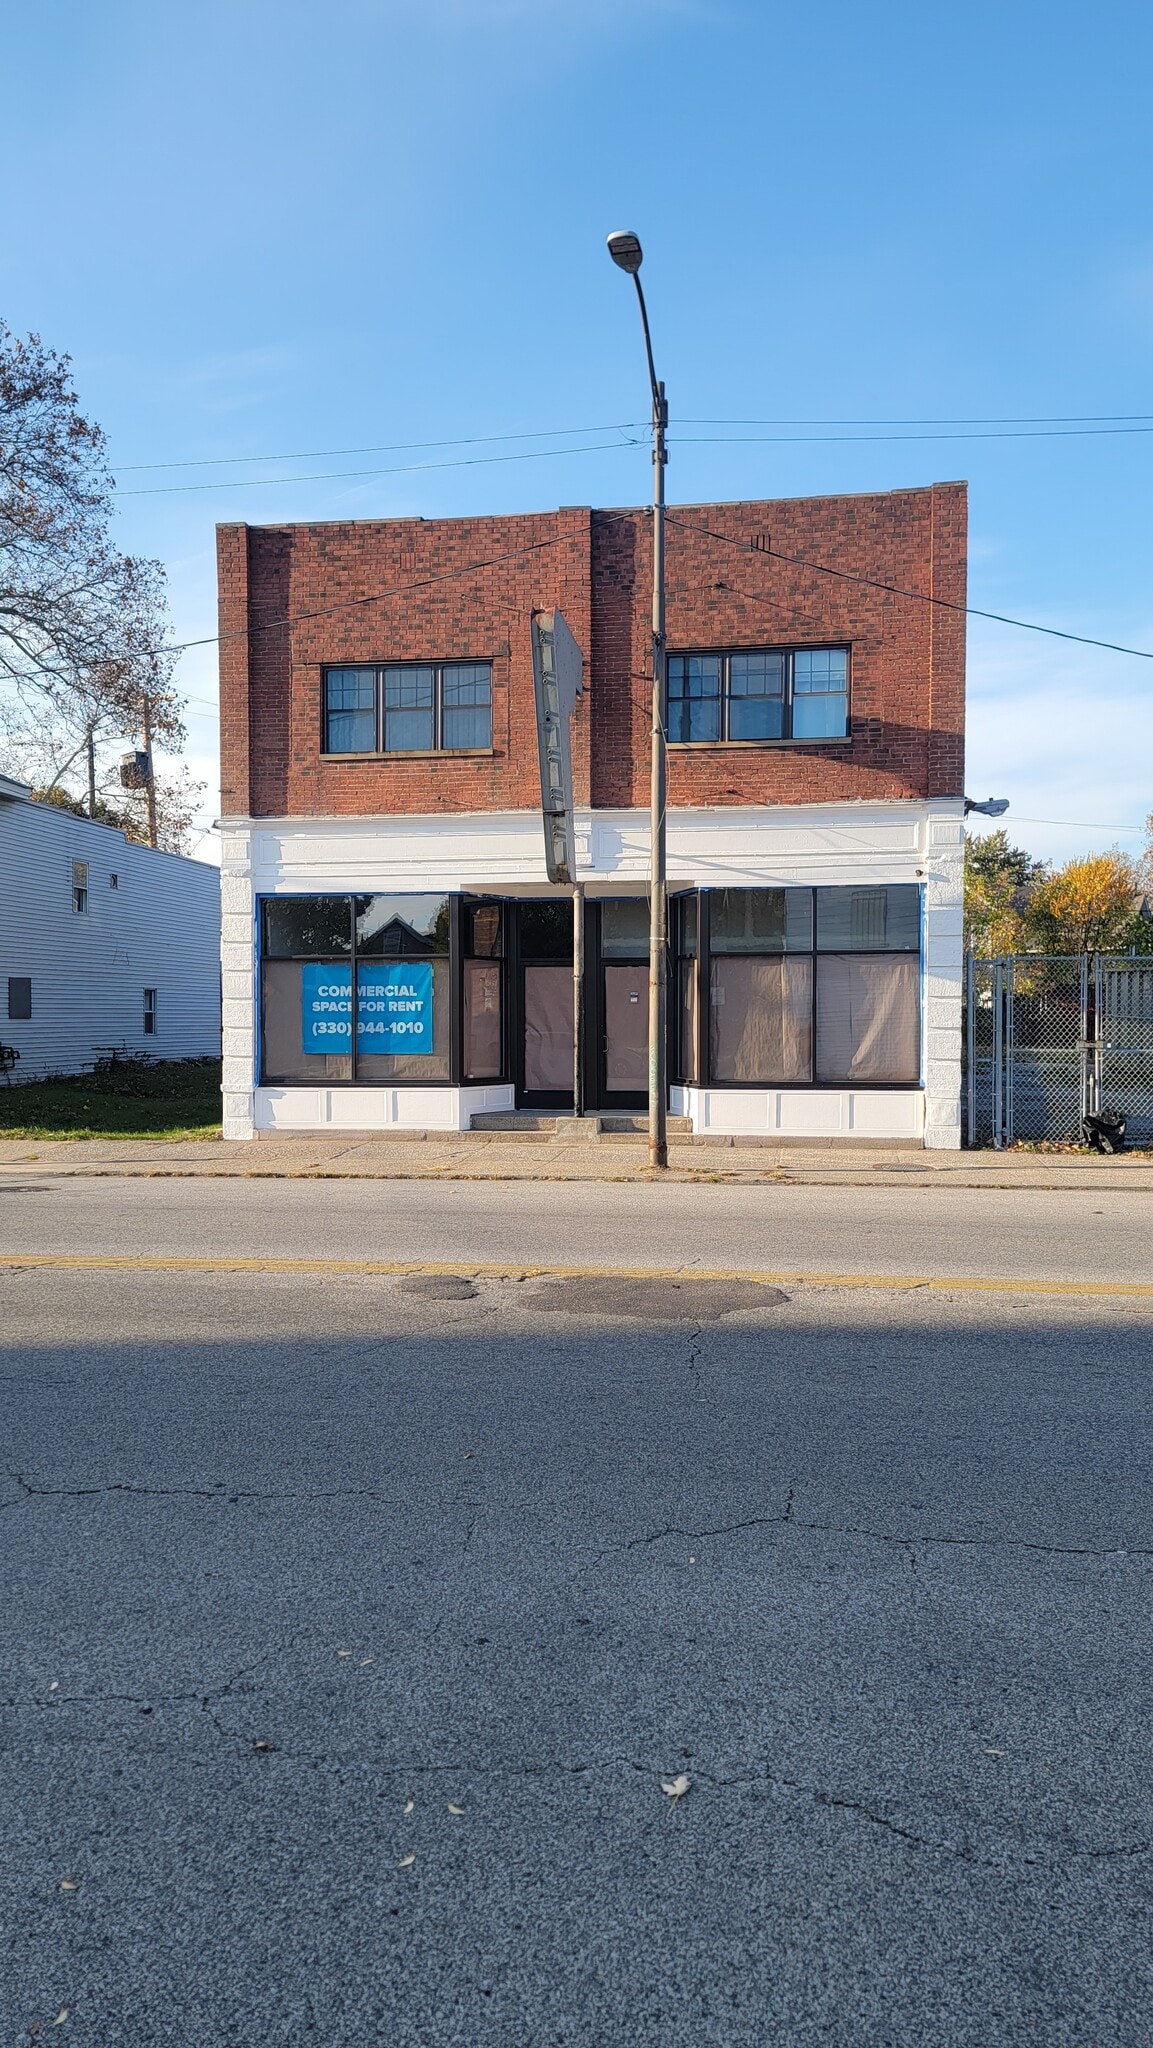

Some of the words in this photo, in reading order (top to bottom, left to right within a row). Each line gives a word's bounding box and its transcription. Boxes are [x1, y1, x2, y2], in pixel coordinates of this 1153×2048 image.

[318, 985, 418, 997] COMMERCIAL
[358, 1001, 385, 1012] FOR
[388, 1001, 424, 1012] RENT
[312, 1022, 352, 1036] (330)
[357, 1021, 424, 1034] 944-1010
